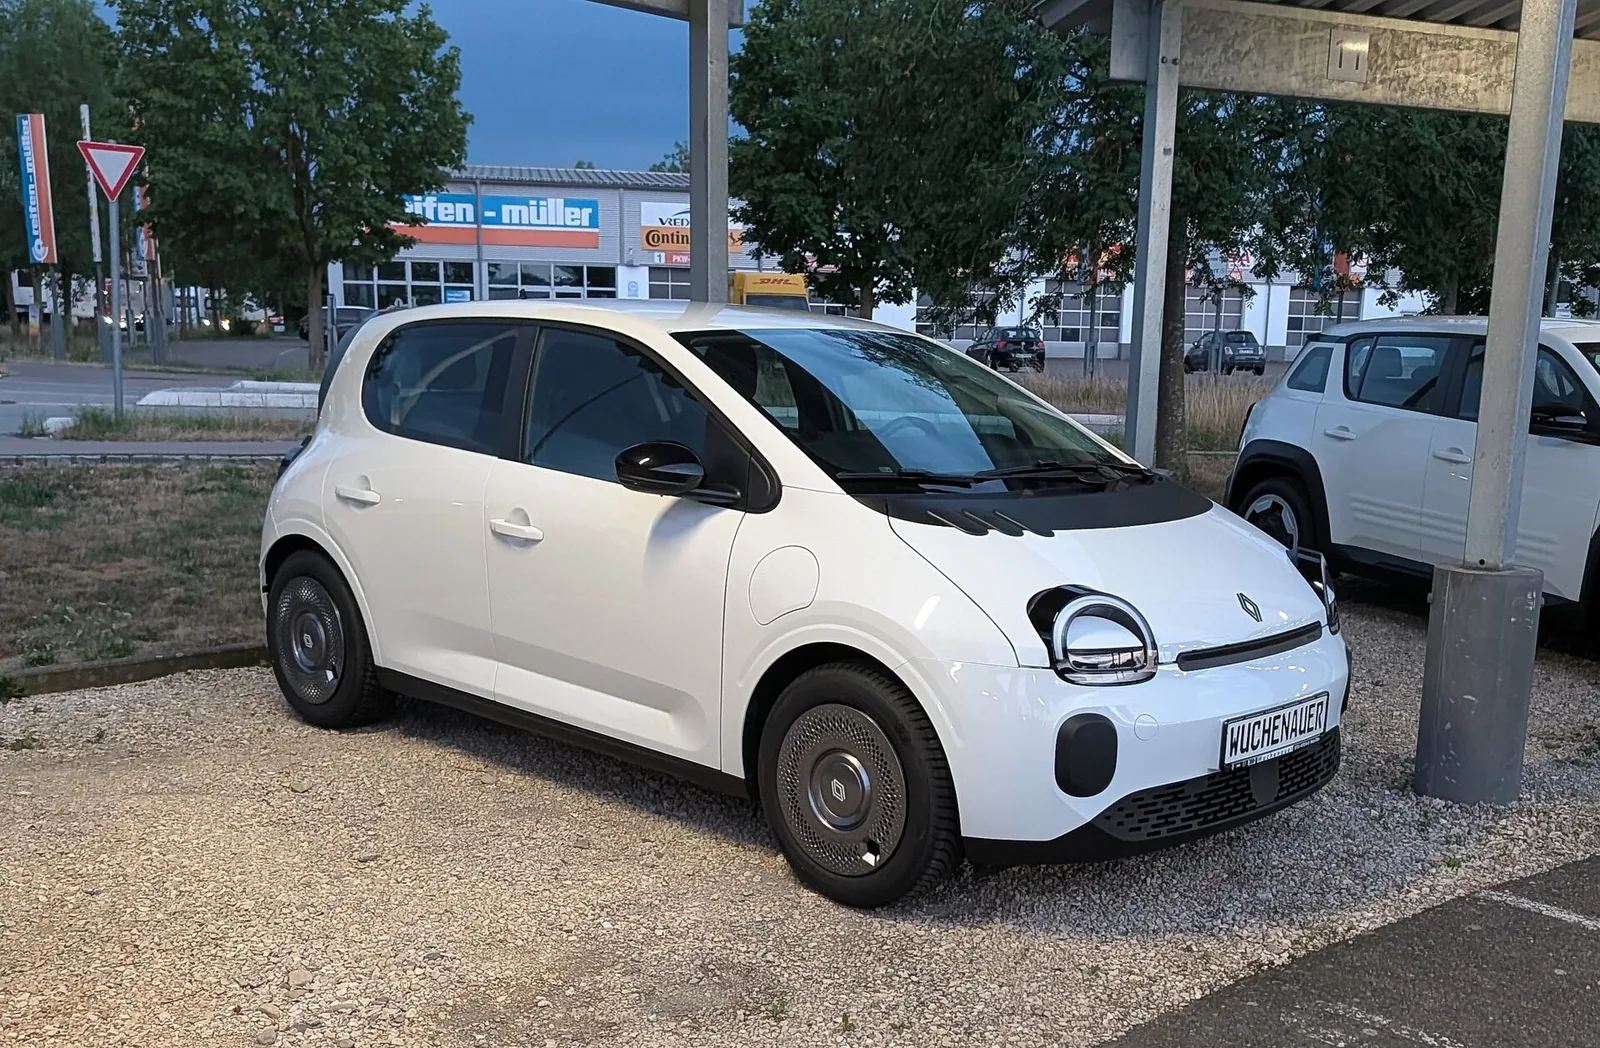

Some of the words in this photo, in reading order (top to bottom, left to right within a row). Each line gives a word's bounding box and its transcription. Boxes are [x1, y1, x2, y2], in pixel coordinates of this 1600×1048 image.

[501, 199, 592, 226] müller
[658, 217, 690, 227] VRED
[646, 229, 690, 248] Contin
[657, 253, 662, 263] 1
[1229, 701, 1324, 758] WUCHENAUER
